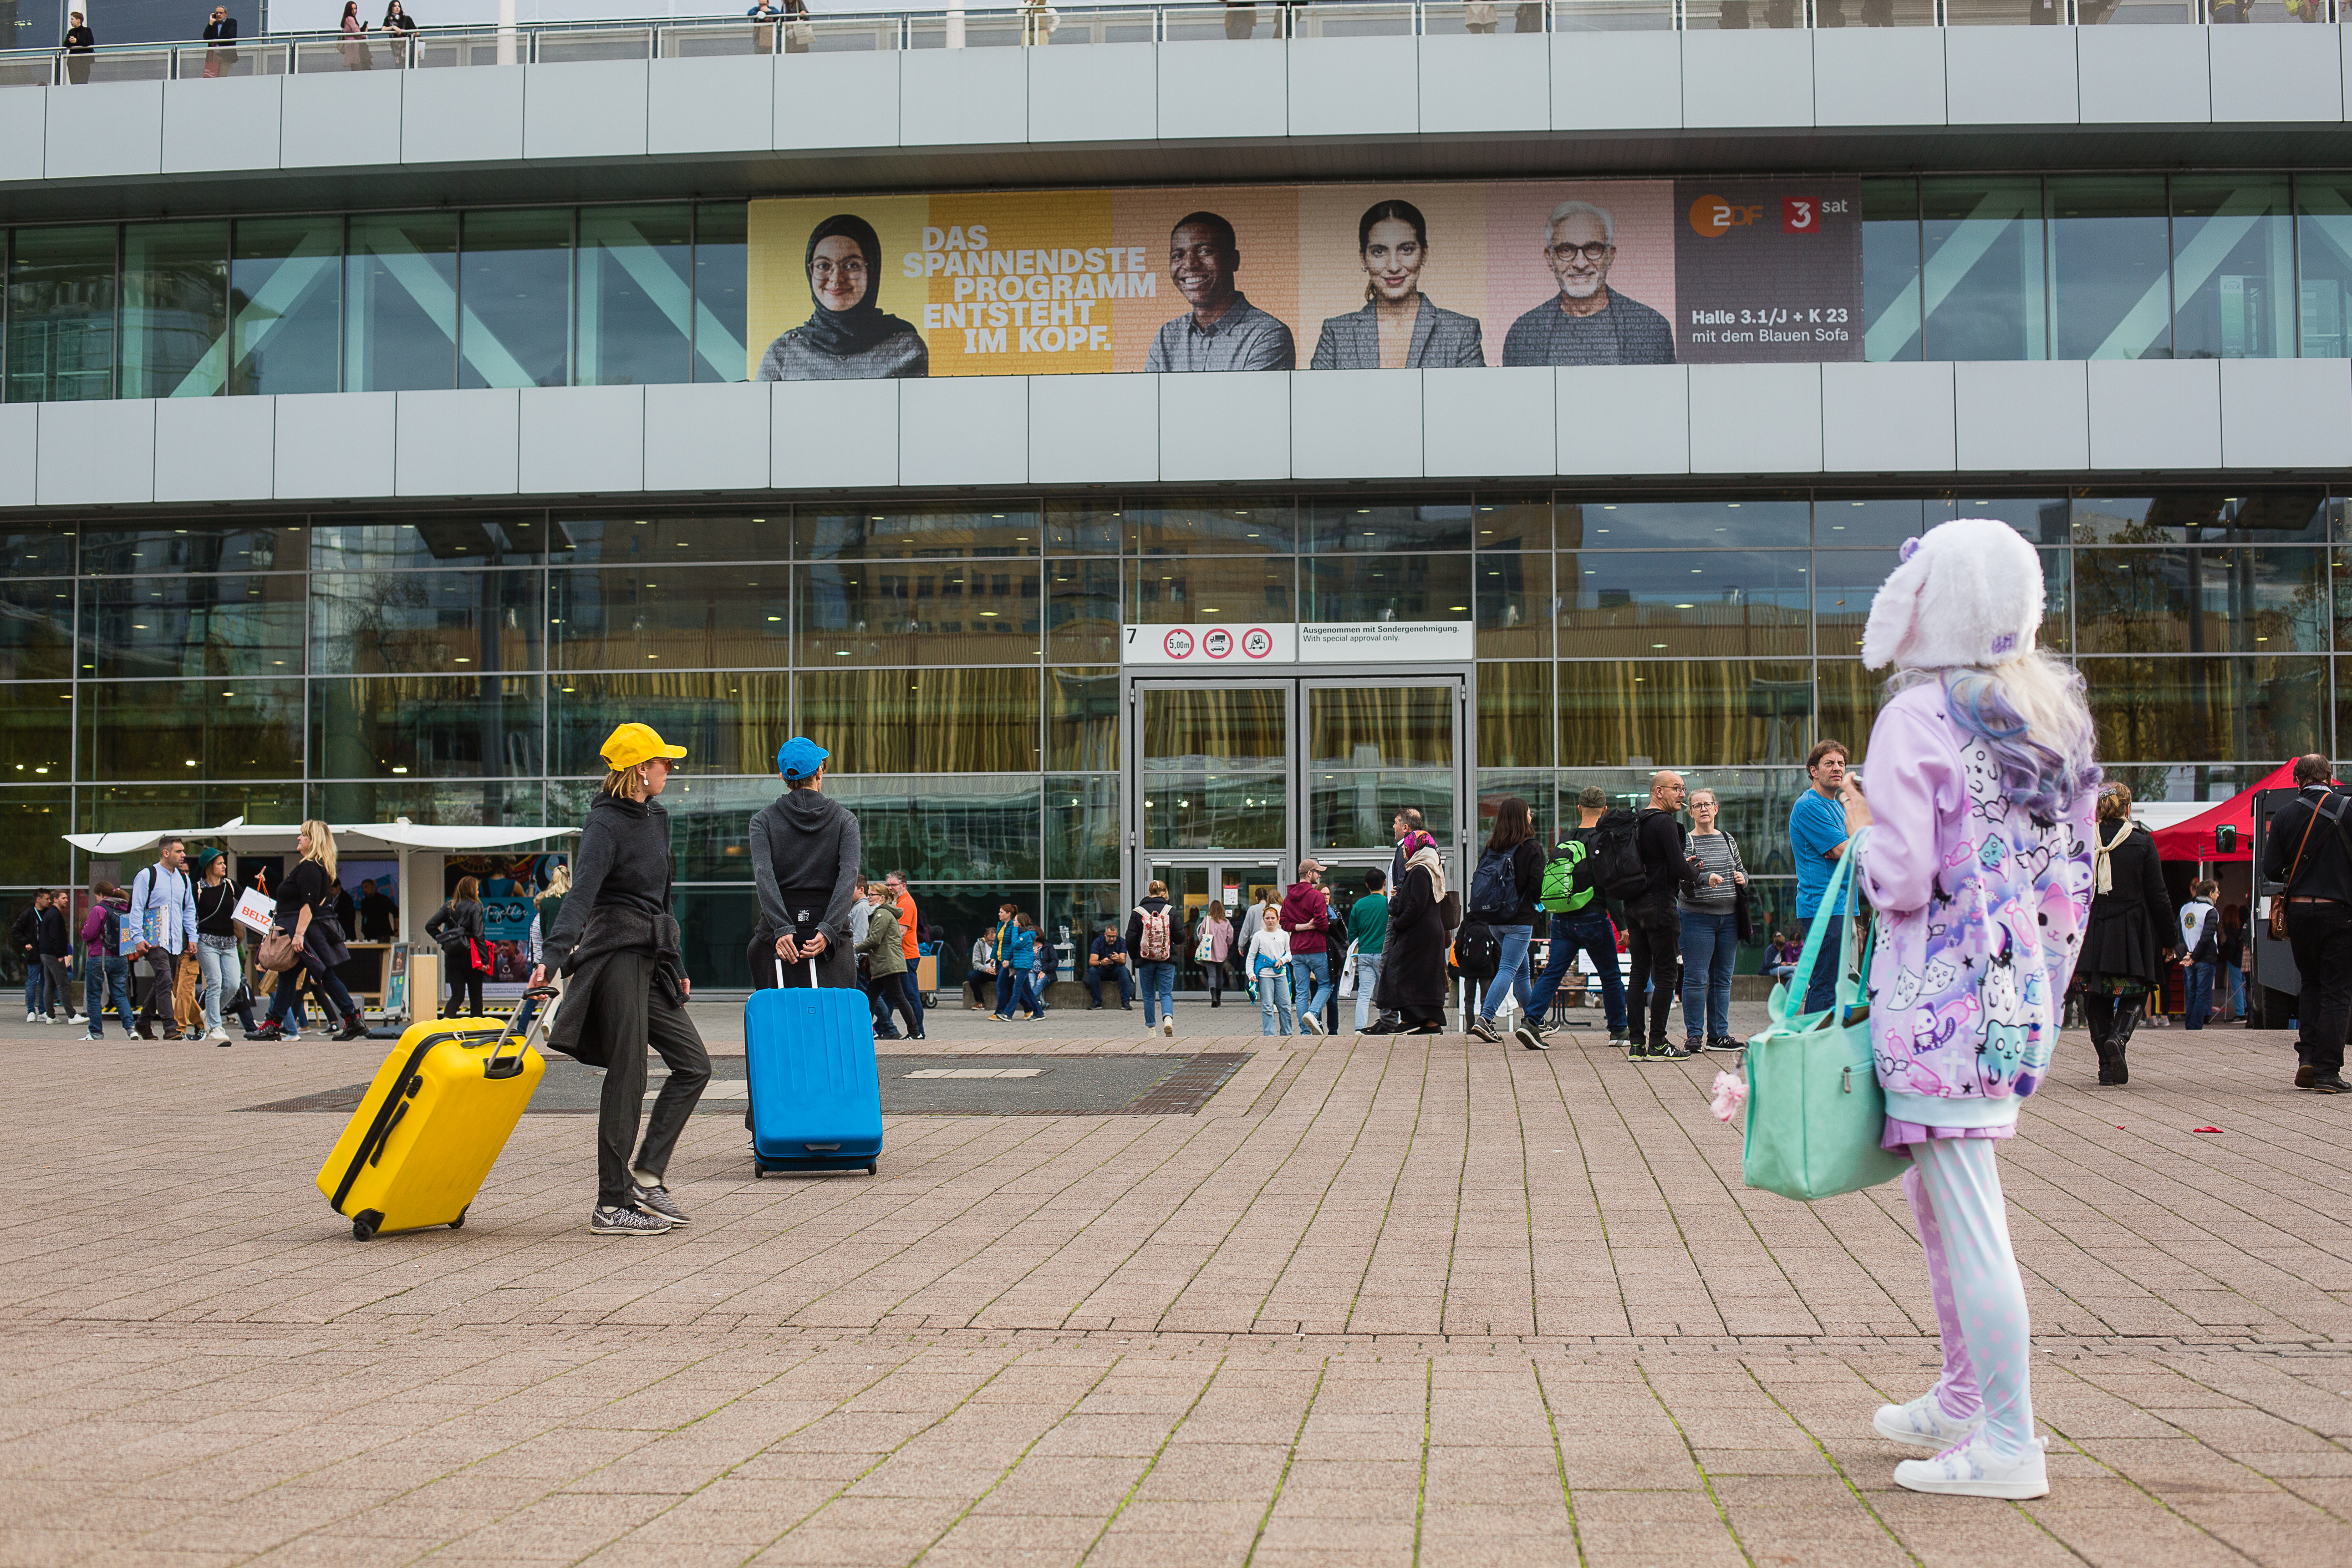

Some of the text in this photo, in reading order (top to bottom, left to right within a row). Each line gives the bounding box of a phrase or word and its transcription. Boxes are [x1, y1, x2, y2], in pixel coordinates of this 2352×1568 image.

[923, 225, 988, 251] DAS
[903, 247, 1146, 278] SPANNENDSTE
[954, 273, 1156, 303] PROGRAMM
[924, 299, 1096, 329] ENTSTEHT
[1692, 309, 1735, 325] Halle
[1740, 308, 1788, 327] 3.1/J
[1809, 308, 1821, 323] K
[1826, 308, 1849, 323] 23
[964, 325, 1112, 354] IM KOPF.
[1692, 327, 1849, 343] mit dem Blauen Sofa
[1126, 629, 1137, 644] 7
[1303, 627, 1361, 635] Ausgenommen
[1378, 625, 1459, 634] Sondergenehmigung.
[1323, 634, 1348, 643] special
[1350, 634, 1381, 643] approval
[241, 905, 272, 926] BELTZ
